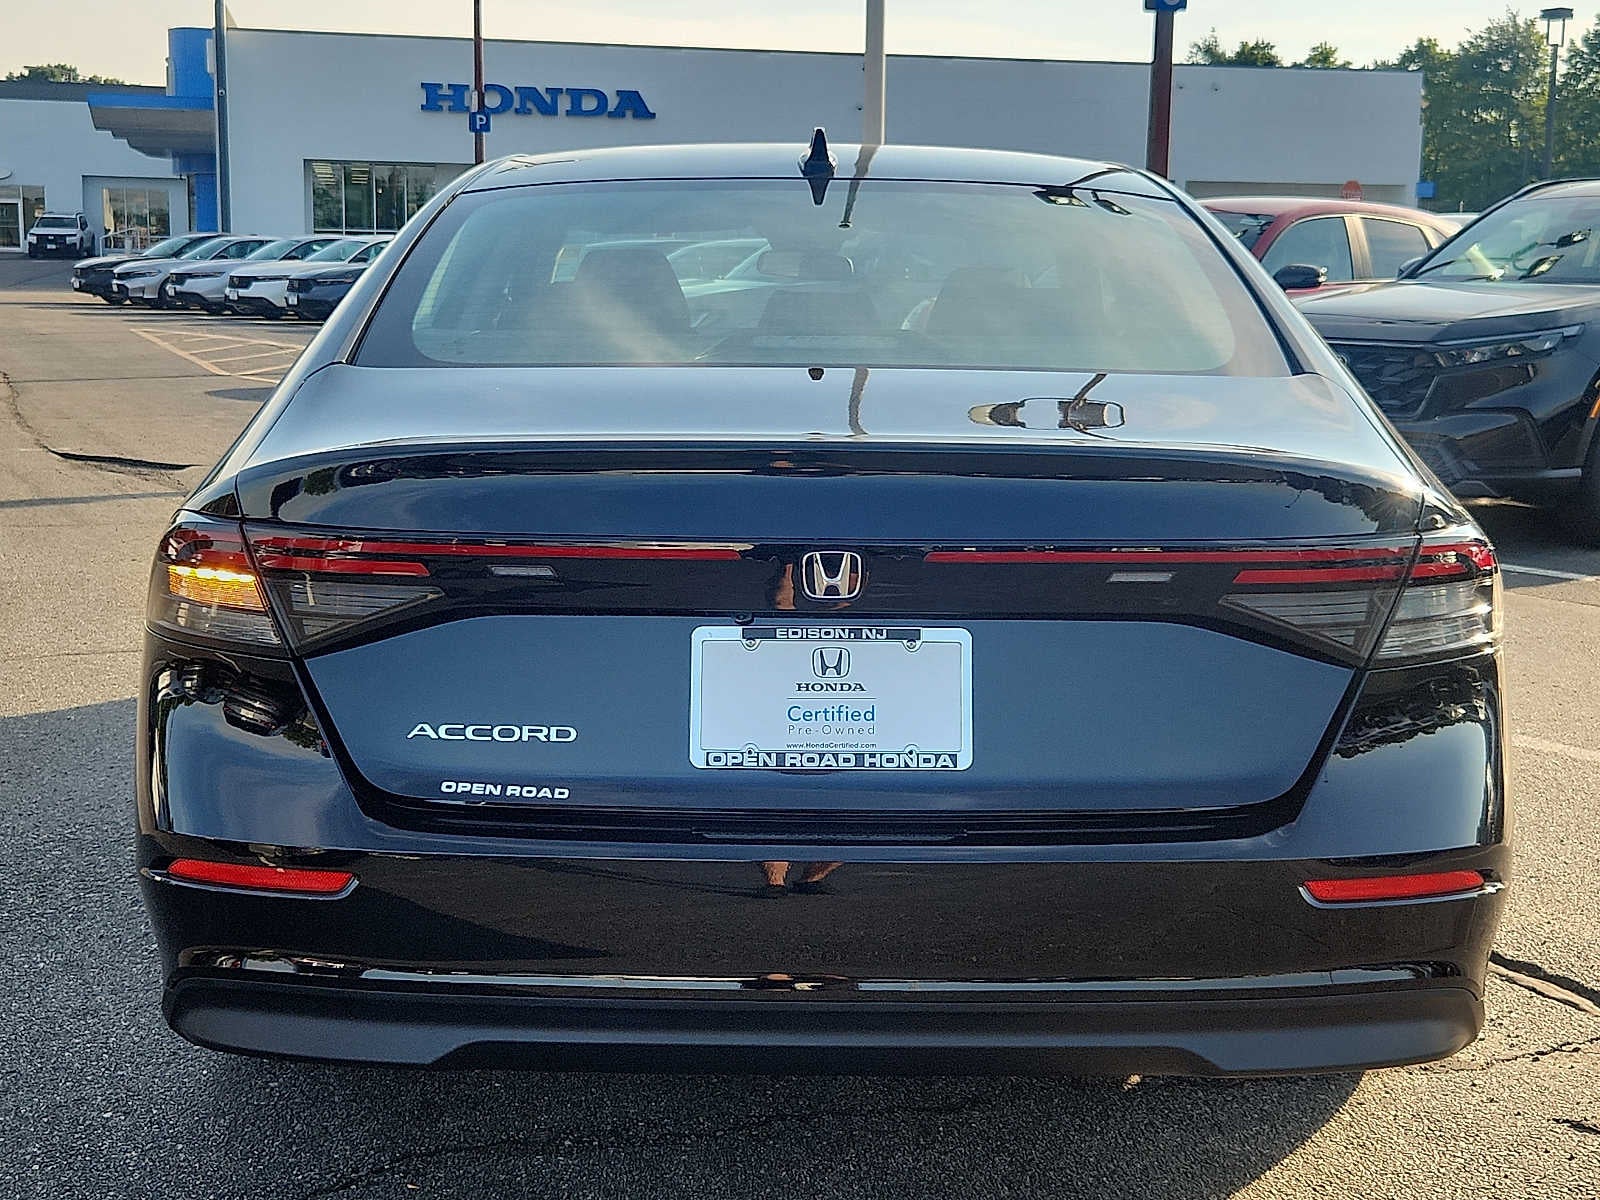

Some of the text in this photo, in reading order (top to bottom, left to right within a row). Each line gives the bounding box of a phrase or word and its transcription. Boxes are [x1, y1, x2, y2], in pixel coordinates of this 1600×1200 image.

[420, 82, 656, 119] HONDA
[476, 115, 487, 129] P
[862, 628, 887, 640] NJ
[796, 682, 867, 692] HONDA
[787, 704, 875, 722] Certified
[406, 722, 578, 743] ACCORD
[788, 724, 875, 735] Pre-Owned
[786, 742, 877, 750] www.HondaCertified.com
[707, 751, 957, 769] OPEN ROAD HONDA
[440, 781, 570, 799] OPEN ROAD
